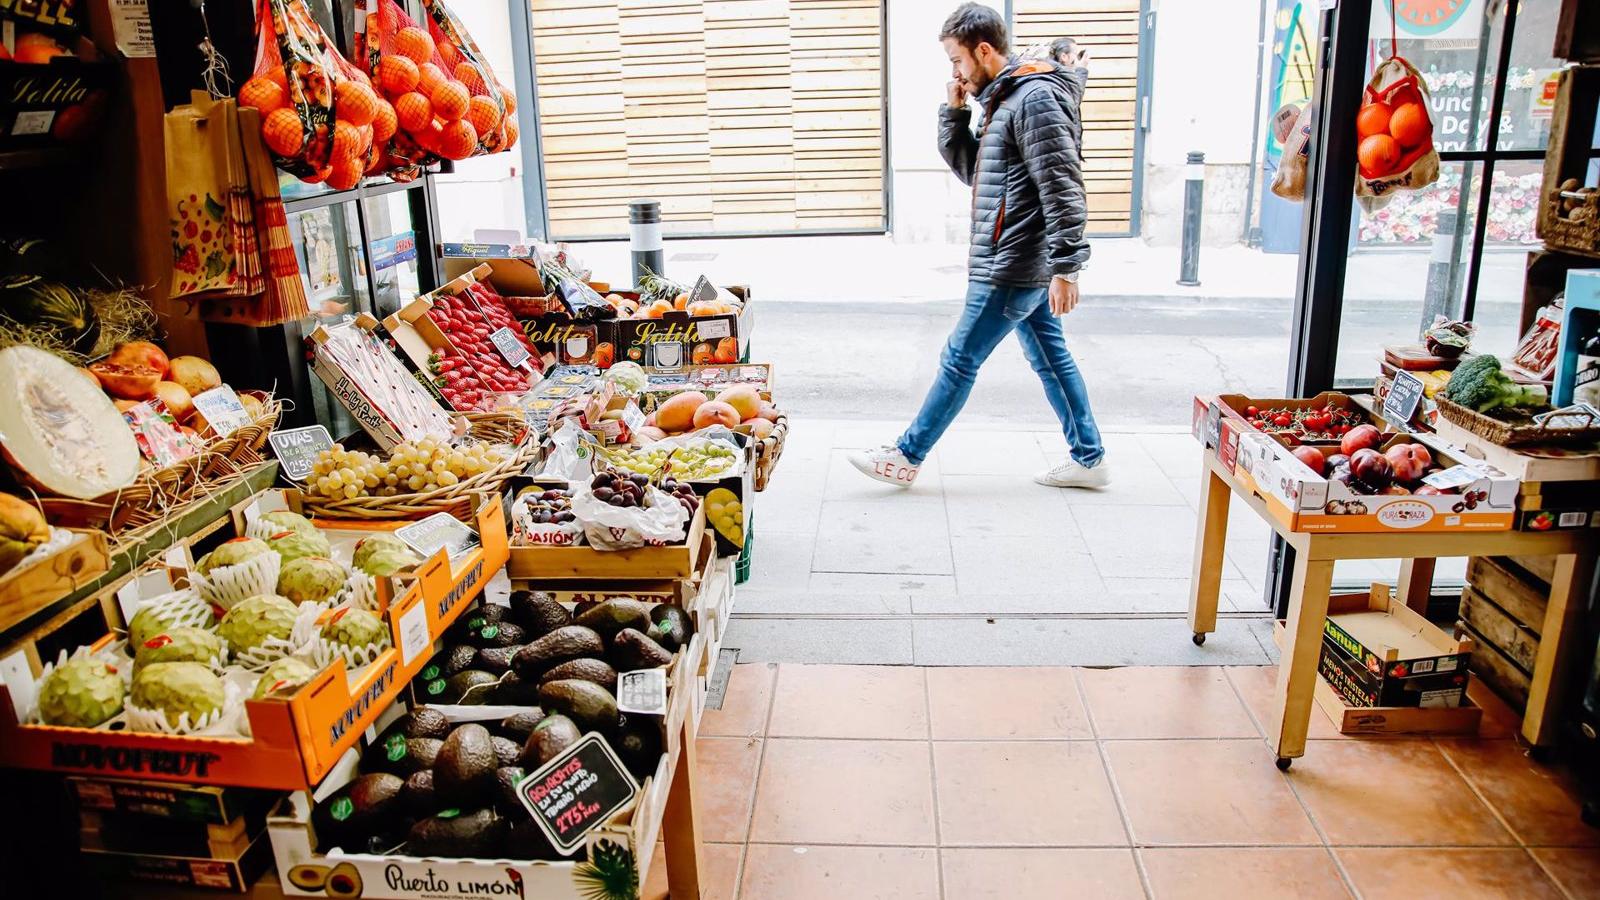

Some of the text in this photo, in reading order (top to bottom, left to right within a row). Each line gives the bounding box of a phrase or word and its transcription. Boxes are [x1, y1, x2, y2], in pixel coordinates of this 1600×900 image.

[12, 78, 87, 104] Lolita
[1431, 94, 1488, 112] unch
[1499, 115, 1514, 134] &
[335, 377, 381, 428] Holly fruit
[279, 431, 312, 448] UVAS
[873, 461, 895, 478] LE
[1408, 511, 1425, 519] RAZA
[1323, 655, 1343, 680] MENOS
[1343, 685, 1364, 707] CEREZ
[528, 757, 582, 804] AGUACATES
[549, 785, 564, 799] SU
[384, 863, 519, 895] Puerto LIMÓN
